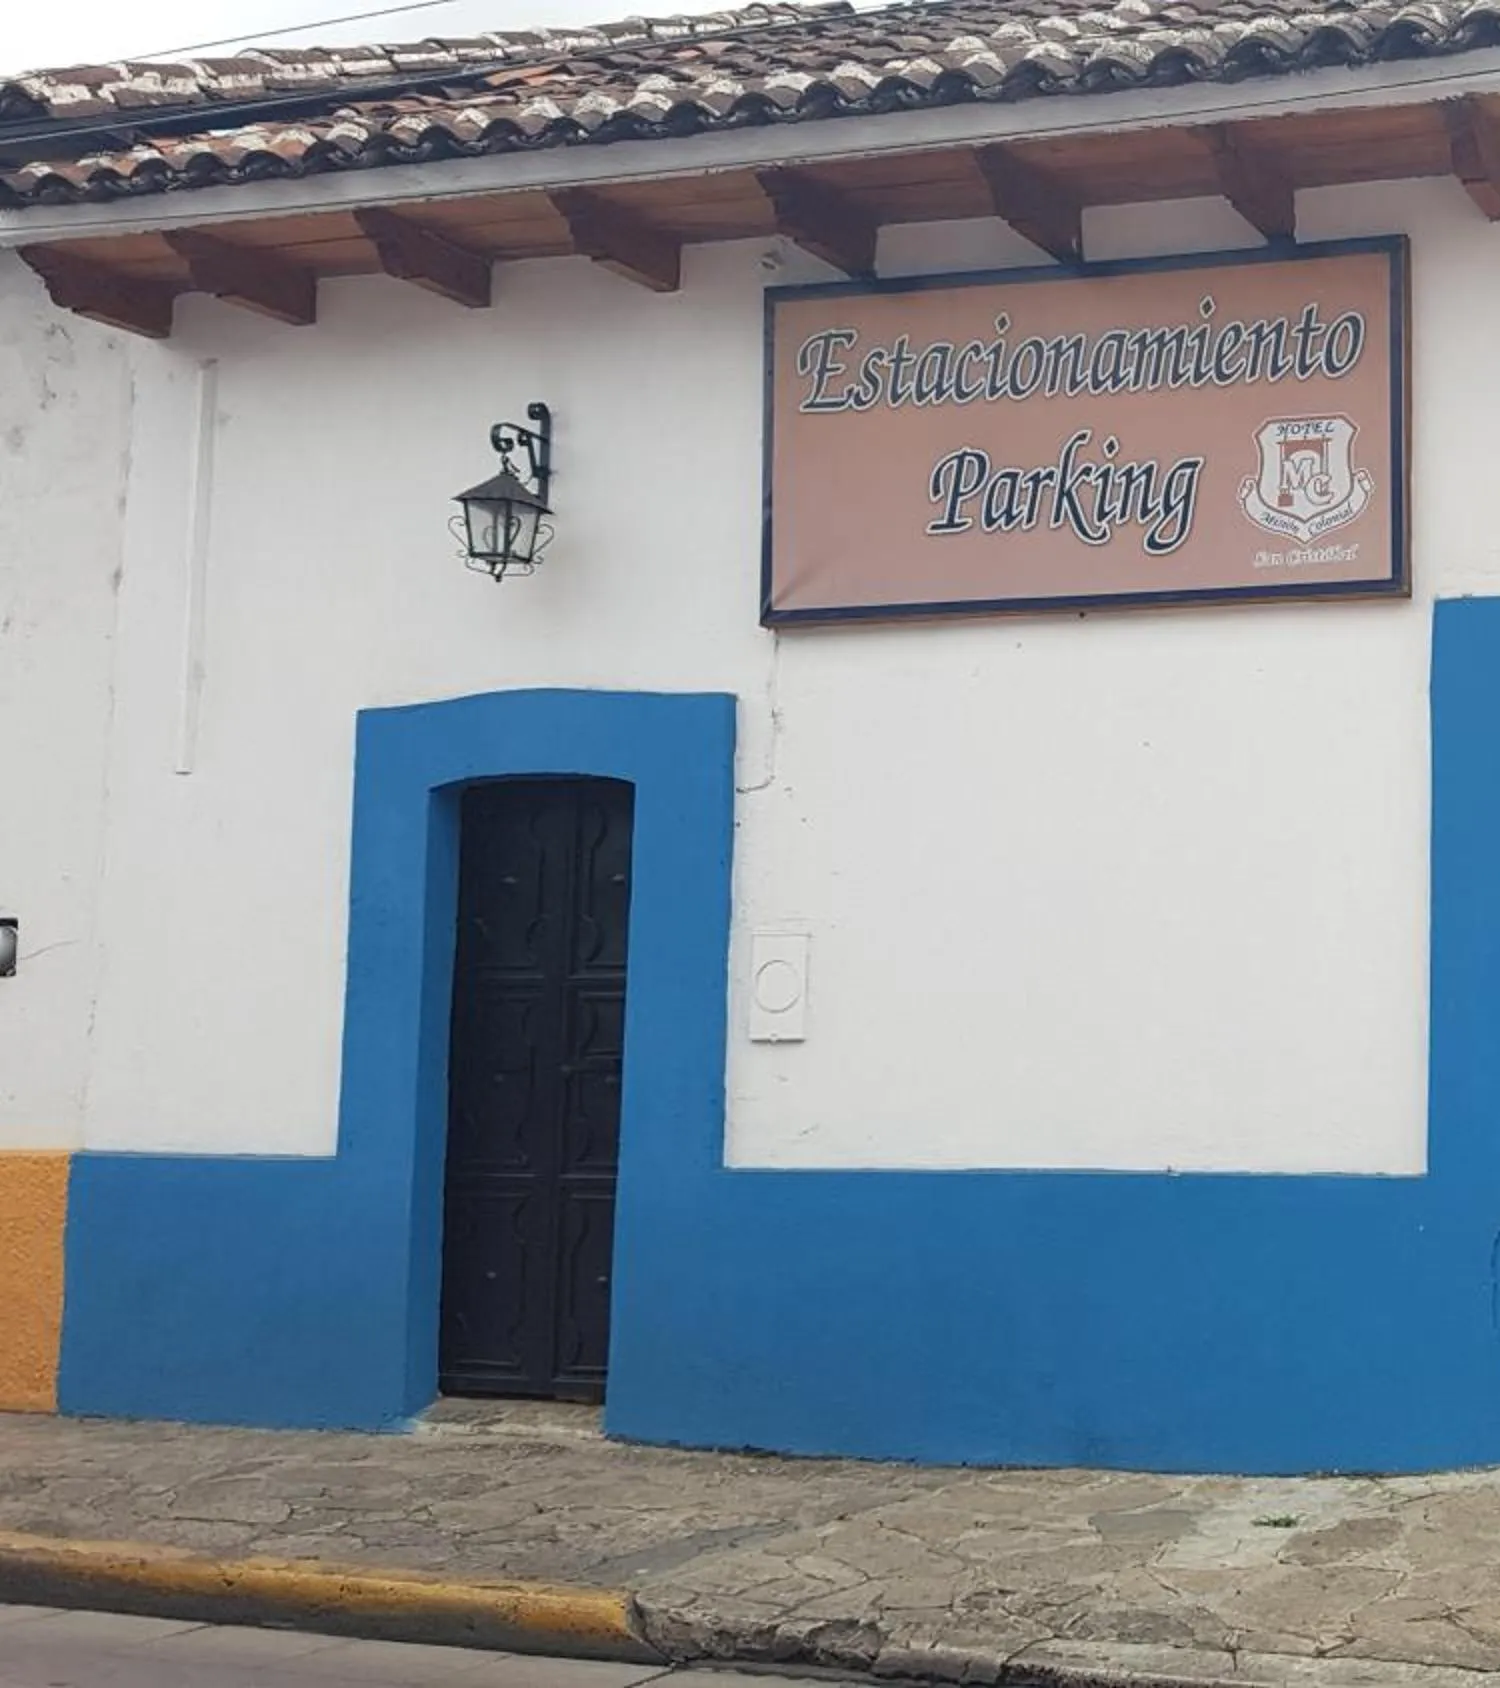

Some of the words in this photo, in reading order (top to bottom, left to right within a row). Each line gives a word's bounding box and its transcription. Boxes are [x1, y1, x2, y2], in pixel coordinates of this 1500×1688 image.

[799, 298, 1363, 412] Estacionamiento
[1276, 422, 1335, 436] HOTEL
[928, 431, 1203, 554] Parking
